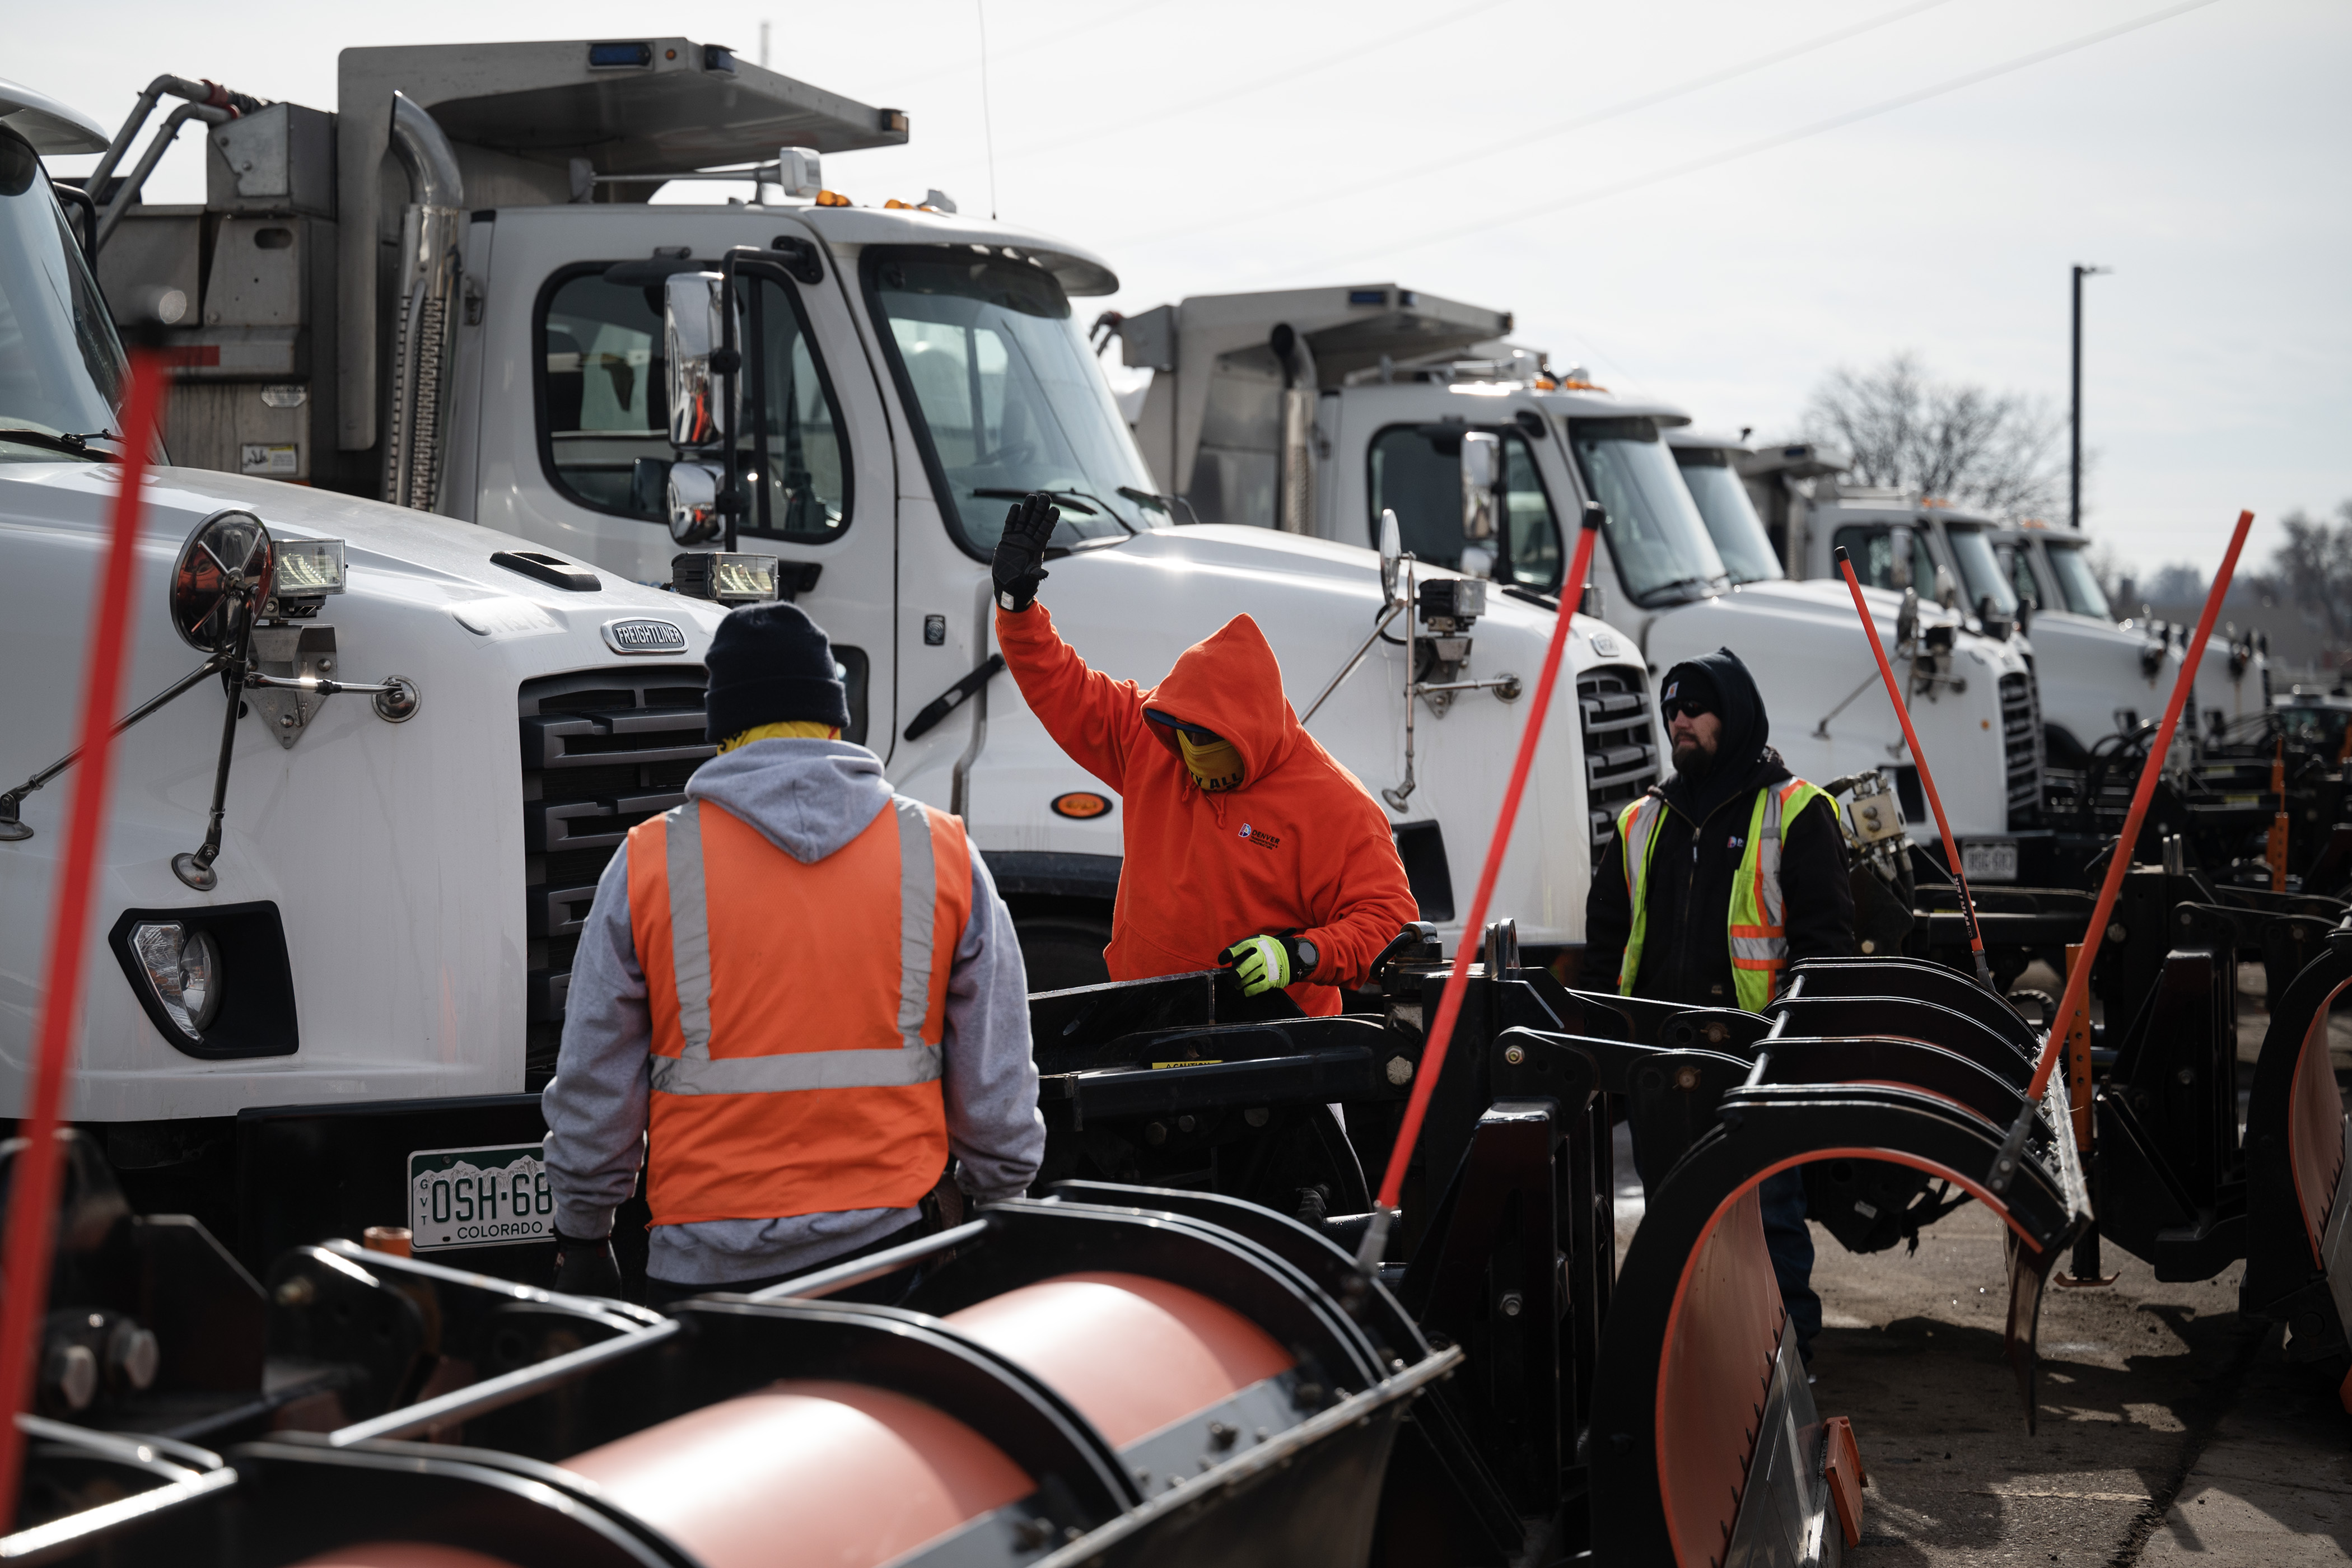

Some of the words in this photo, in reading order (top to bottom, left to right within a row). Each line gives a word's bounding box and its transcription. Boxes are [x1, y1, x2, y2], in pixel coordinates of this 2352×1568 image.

[615, 625, 682, 644] FREIGHTLINER
[1210, 773, 1242, 789] ALL
[1252, 829, 1280, 844] DENVER
[432, 1172, 553, 1223] OSH-68
[458, 1221, 543, 1239] COLORADO
